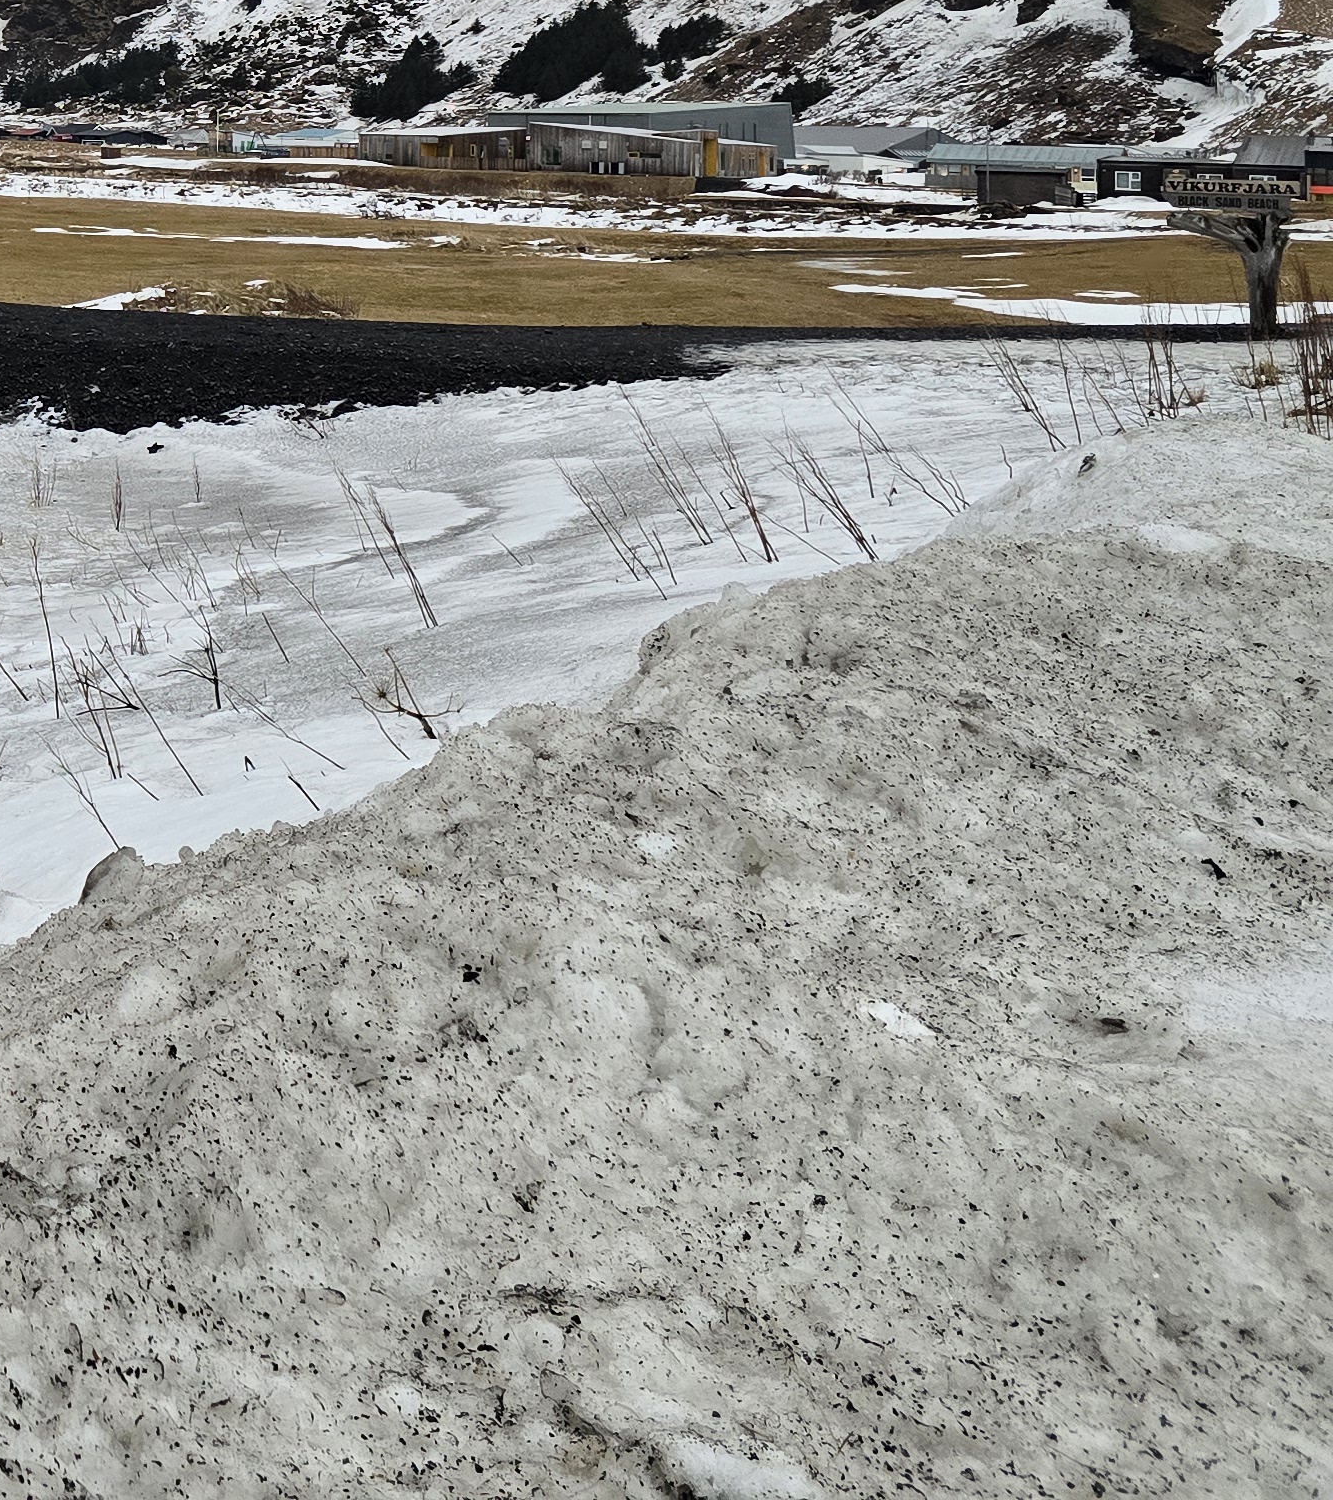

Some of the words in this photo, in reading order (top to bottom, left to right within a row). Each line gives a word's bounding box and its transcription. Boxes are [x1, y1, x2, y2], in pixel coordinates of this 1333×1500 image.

[1168, 179, 1297, 194] VÍKURFJARA
[1178, 196, 1209, 207] BLACK
[1215, 197, 1242, 208] SAND
[1248, 198, 1280, 209] BEACH
